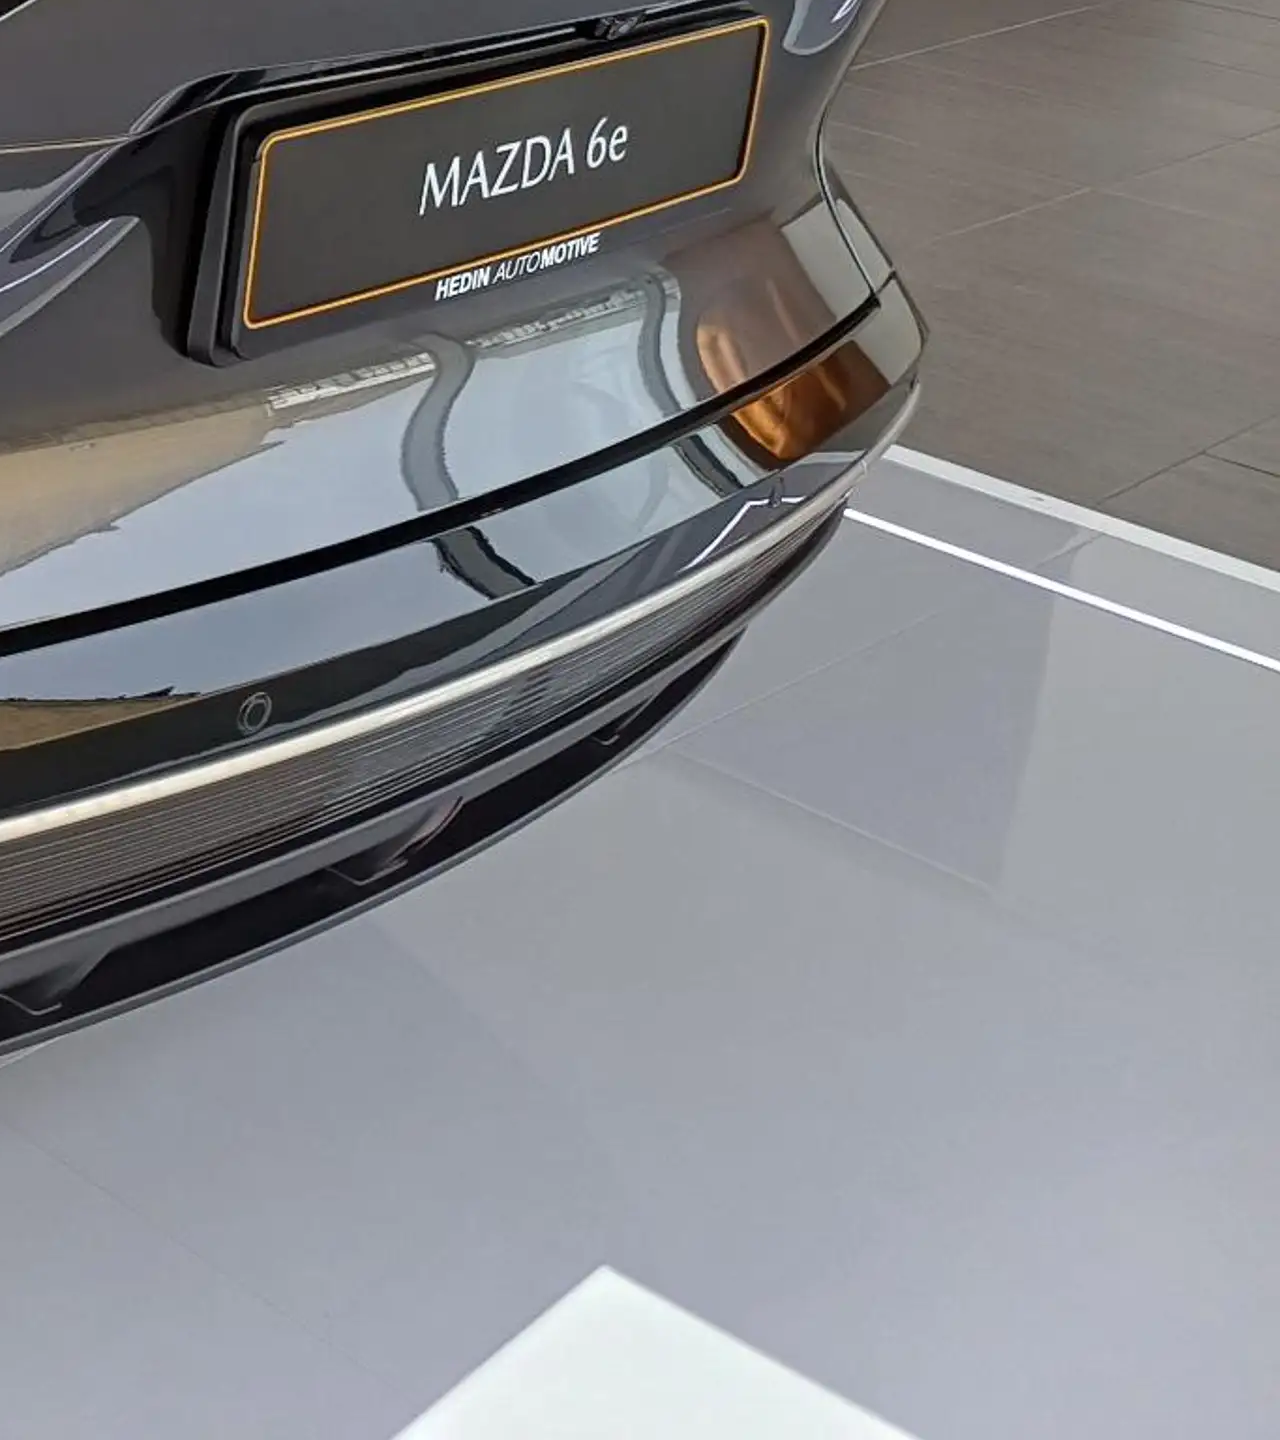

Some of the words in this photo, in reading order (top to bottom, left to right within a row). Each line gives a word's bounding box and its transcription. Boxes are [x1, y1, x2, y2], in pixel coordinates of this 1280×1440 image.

[419, 127, 575, 216] MAZDA
[587, 117, 628, 168] 6e
[435, 267, 492, 301] HEDIN
[493, 232, 602, 285] AUTOMOTIVE
